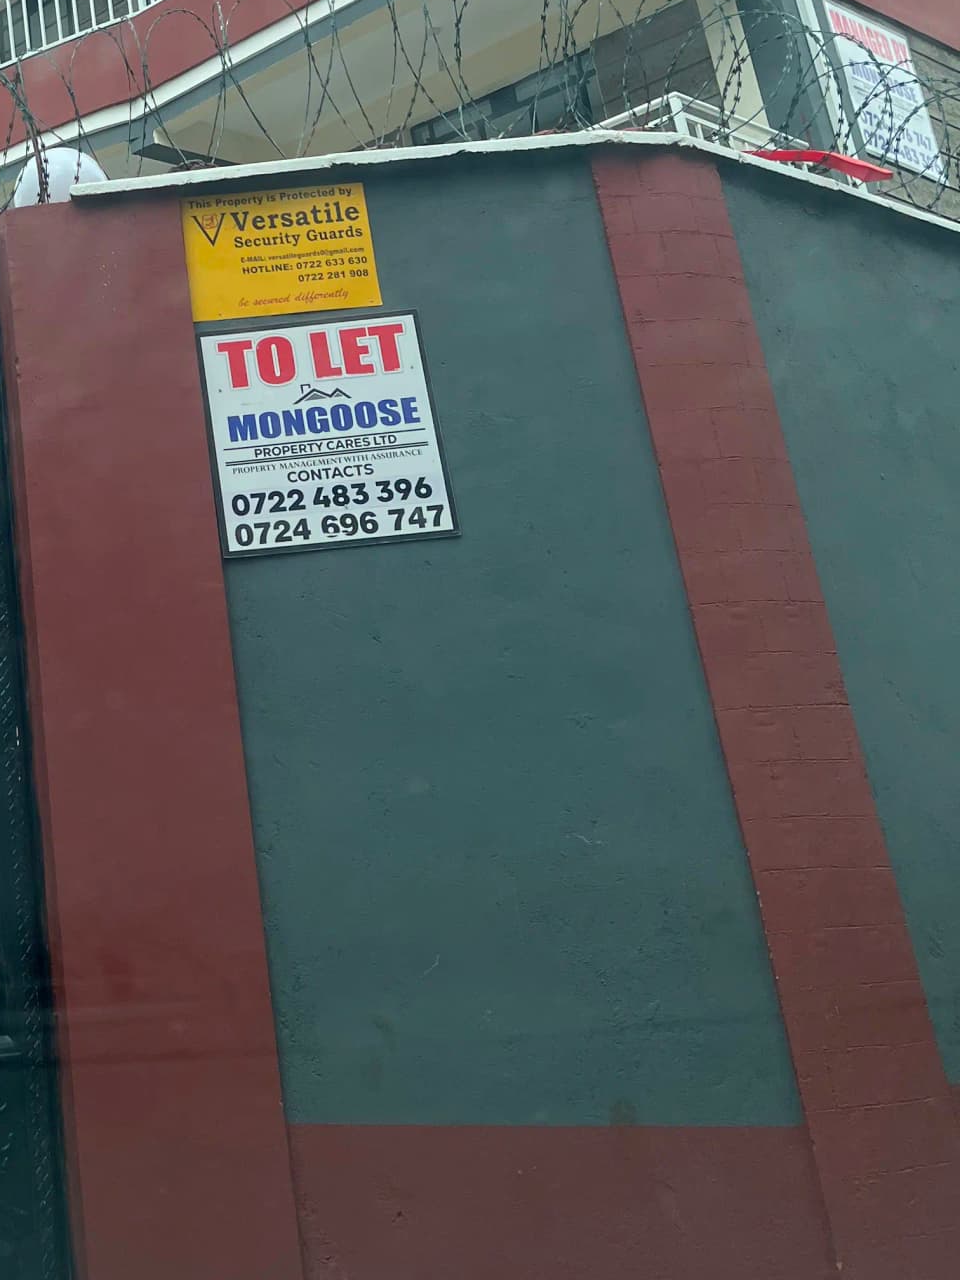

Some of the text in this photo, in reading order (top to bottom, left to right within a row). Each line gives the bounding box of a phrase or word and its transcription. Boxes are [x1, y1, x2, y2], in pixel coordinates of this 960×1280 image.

[188, 186, 352, 210] This Property is Protected by
[230, 201, 360, 232] Versatile
[234, 225, 363, 248] Security Guards
[242, 256, 368, 275] HOTLINE: 0722 633 630
[298, 272, 325, 282] 0722
[349, 269, 369, 278] 908
[294, 287, 349, 304] differently
[216, 322, 405, 389] TO LET
[227, 396, 421, 443] MONGOOSE
[254, 434, 397, 458] PROPERTY CARES LTD
[232, 448, 423, 475] PROPERTY MANAGEMENT WITH ASSURANCE
[287, 463, 374, 483] CONTACTS
[231, 477, 433, 516] 0722 483 396
[235, 504, 444, 546] 0724 696 747
